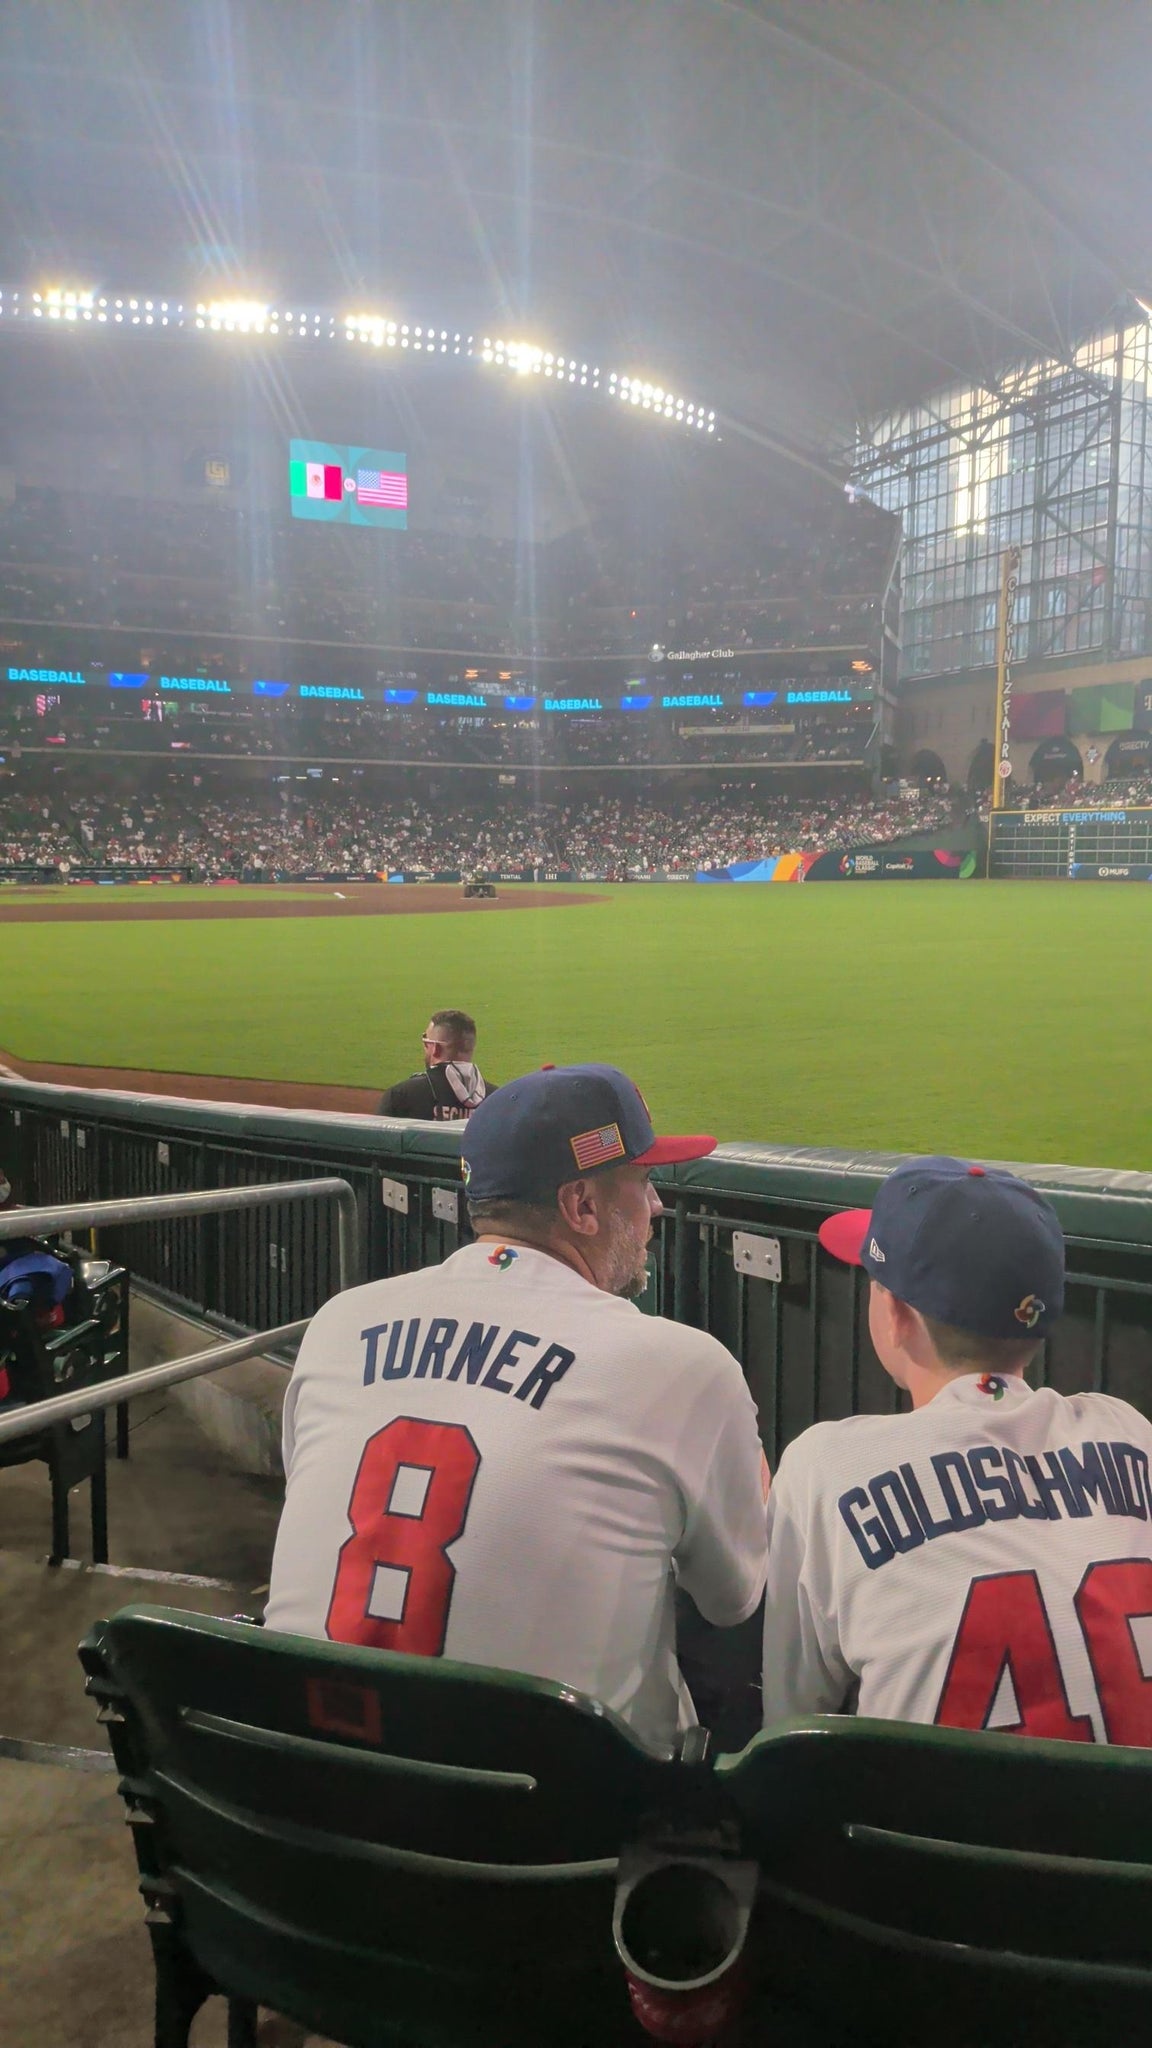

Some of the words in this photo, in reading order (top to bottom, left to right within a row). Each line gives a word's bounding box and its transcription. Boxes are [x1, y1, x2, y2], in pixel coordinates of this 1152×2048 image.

[667, 650, 710, 661] Gallagher
[711, 649, 735, 658] Club
[8, 668, 86, 684] BASEBALL
[160, 677, 231, 692] BASEBALL
[300, 685, 365, 700] BASEBALL
[787, 690, 852, 704] BASEBALL
[427, 693, 487, 707] BASEBALL
[544, 698, 603, 711] BASEBALL
[662, 694, 723, 708] BASEBALL
[1001, 699, 1011, 758] FAIR
[1024, 813, 1061, 823] EXPECT
[1062, 811, 1126, 822] EVERYTHING
[1110, 868, 1129, 876] MUFG
[360, 1317, 577, 1410] TURNER
[838, 1440, 1152, 1570] GOLDSCHMID
[325, 1415, 482, 1657] 8
